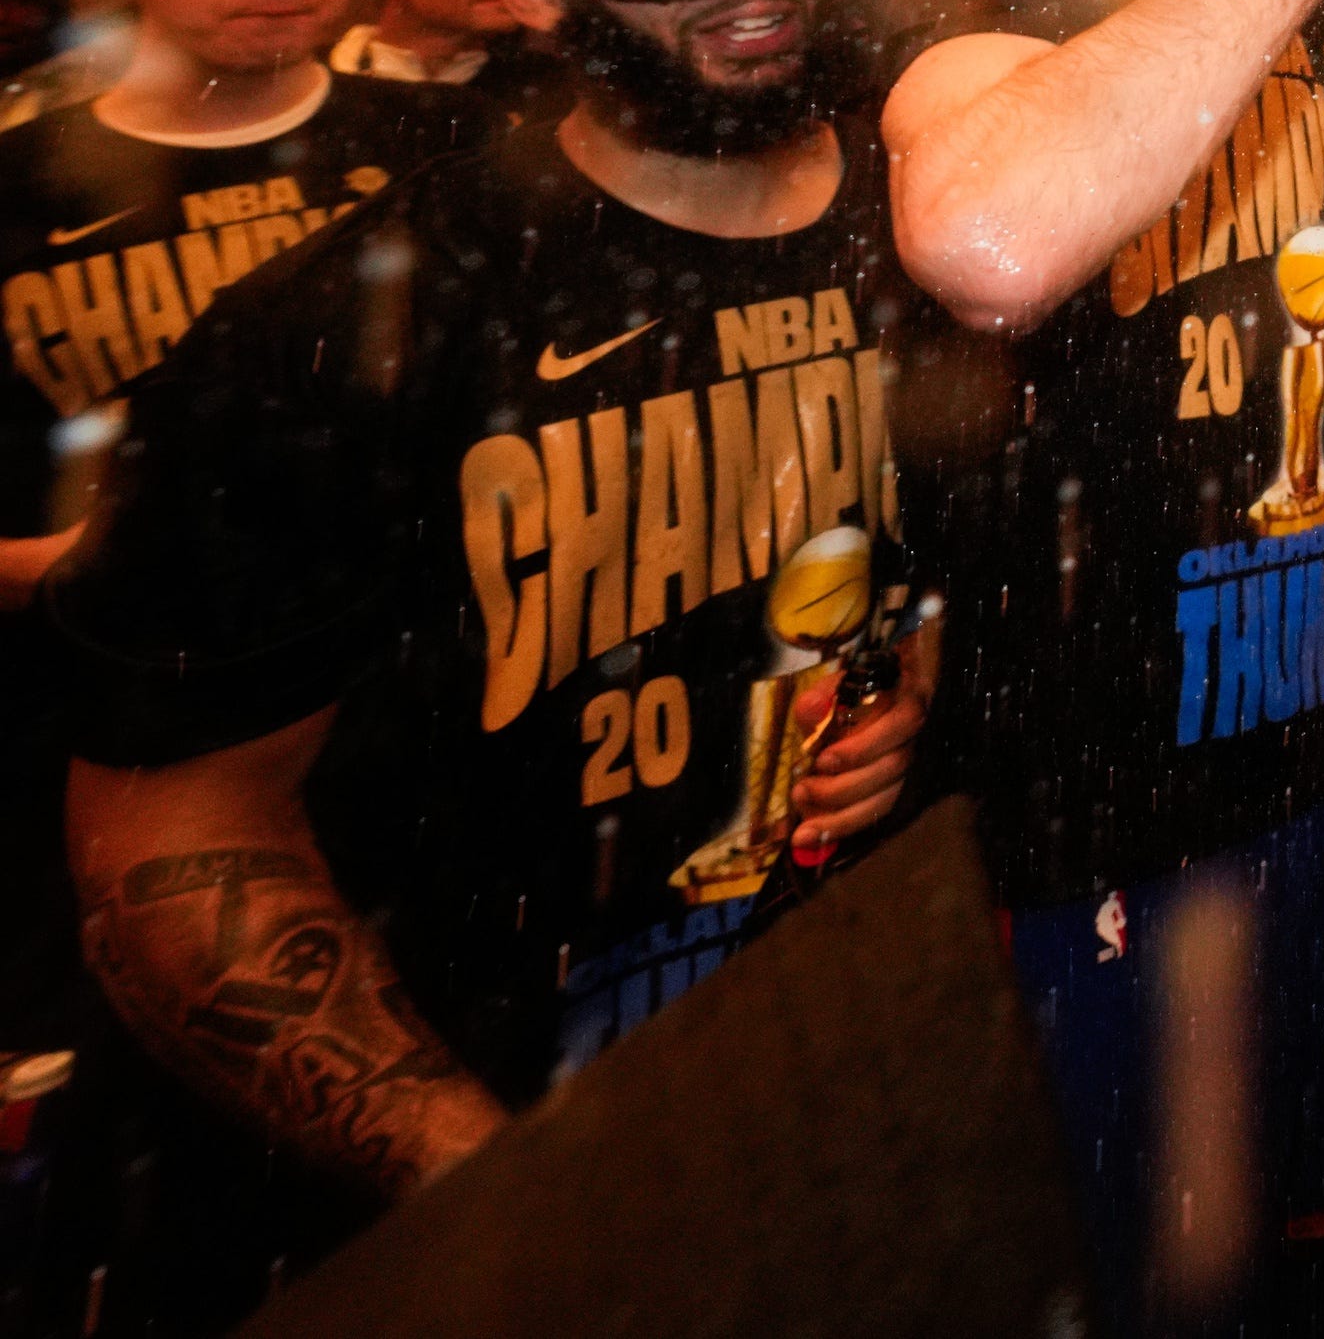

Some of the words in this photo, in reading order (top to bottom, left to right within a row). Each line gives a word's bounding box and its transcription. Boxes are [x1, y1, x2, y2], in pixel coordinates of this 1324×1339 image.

[181, 176, 304, 231] NBA
[714, 287, 860, 376] NBA
[1176, 313, 1244, 420] 20
[459, 347, 904, 734] CHAMPI
[580, 674, 692, 807] 20
